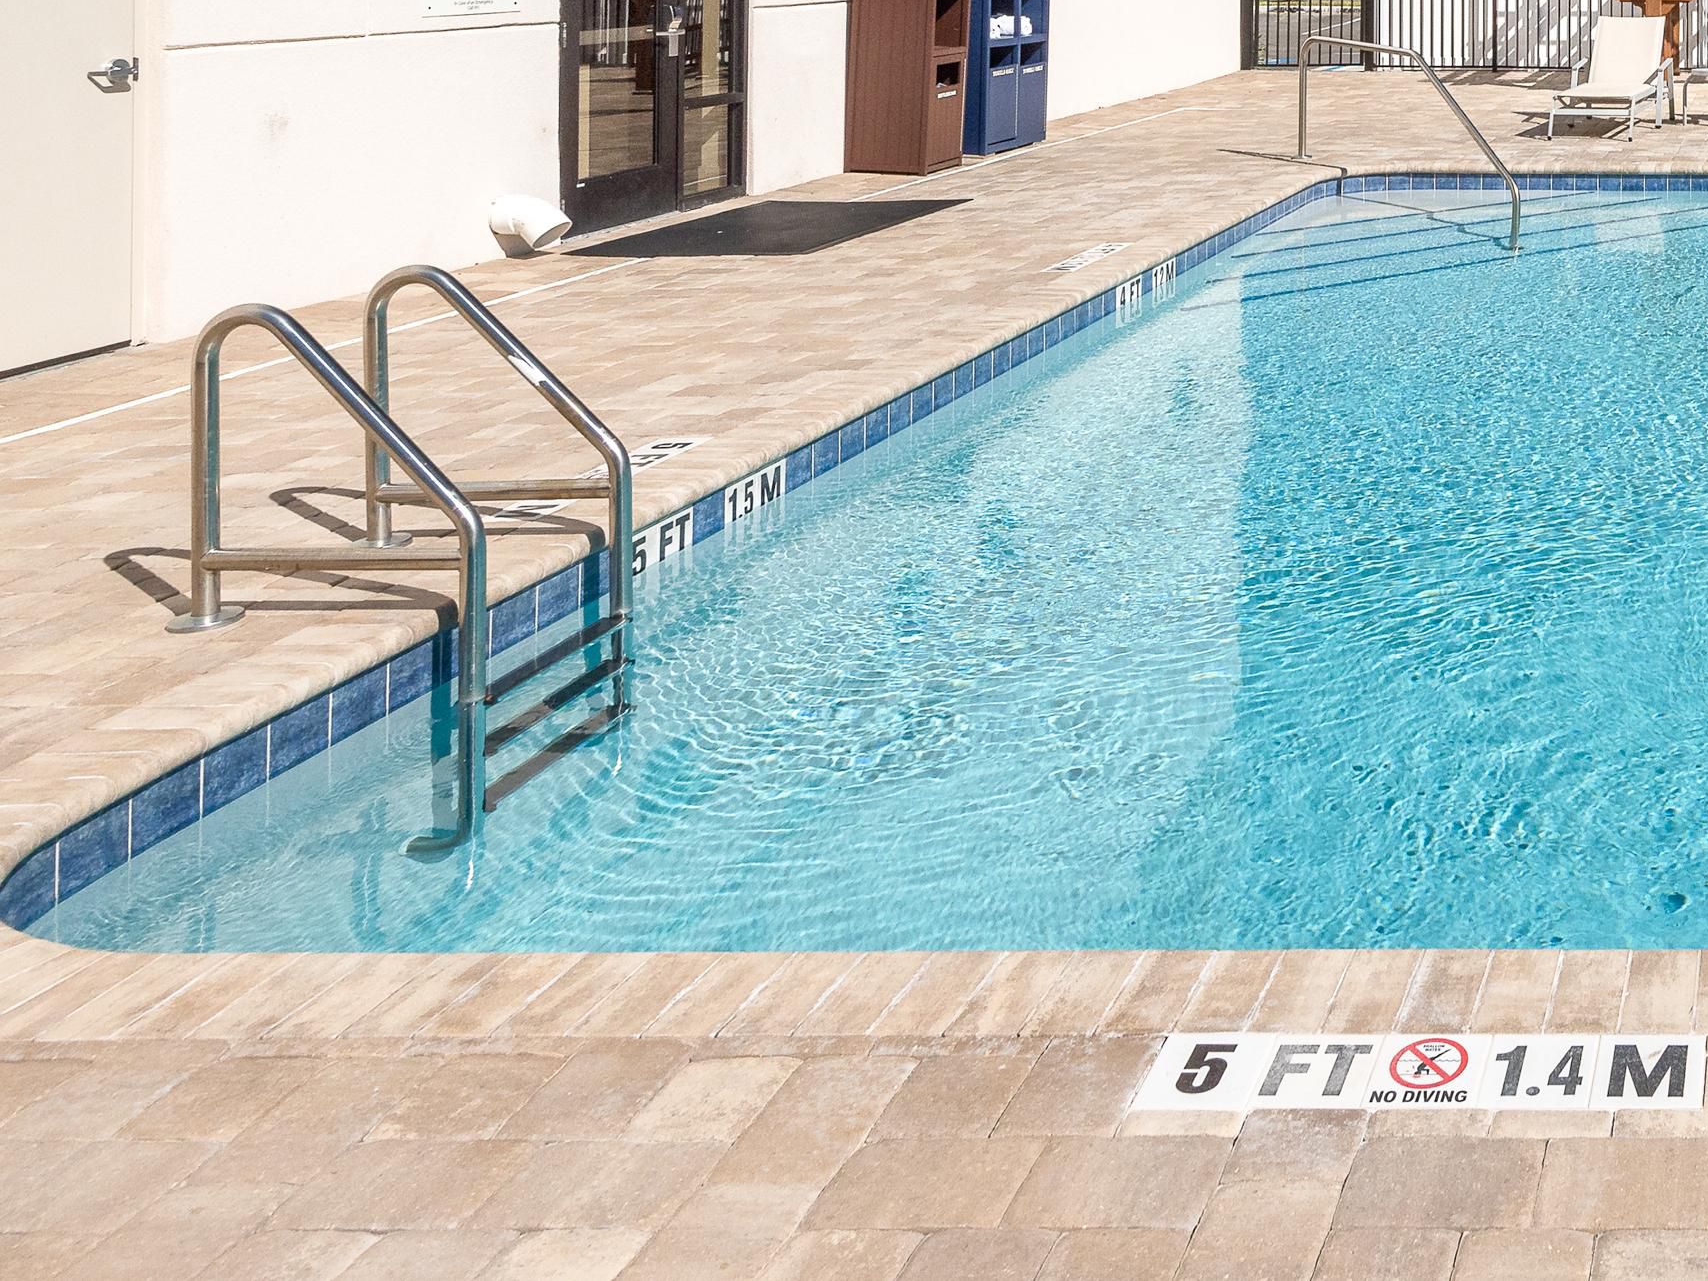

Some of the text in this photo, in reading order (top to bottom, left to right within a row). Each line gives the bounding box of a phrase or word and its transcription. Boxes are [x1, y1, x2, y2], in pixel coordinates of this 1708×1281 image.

[1119, 278, 1141, 306] 4 FT
[729, 465, 782, 522] 1.5 M
[632, 513, 692, 577] 5 FT
[1175, 1043, 1688, 1098] 5 FT 1.4 M
[1369, 1088, 1469, 1104] NO DIVING
